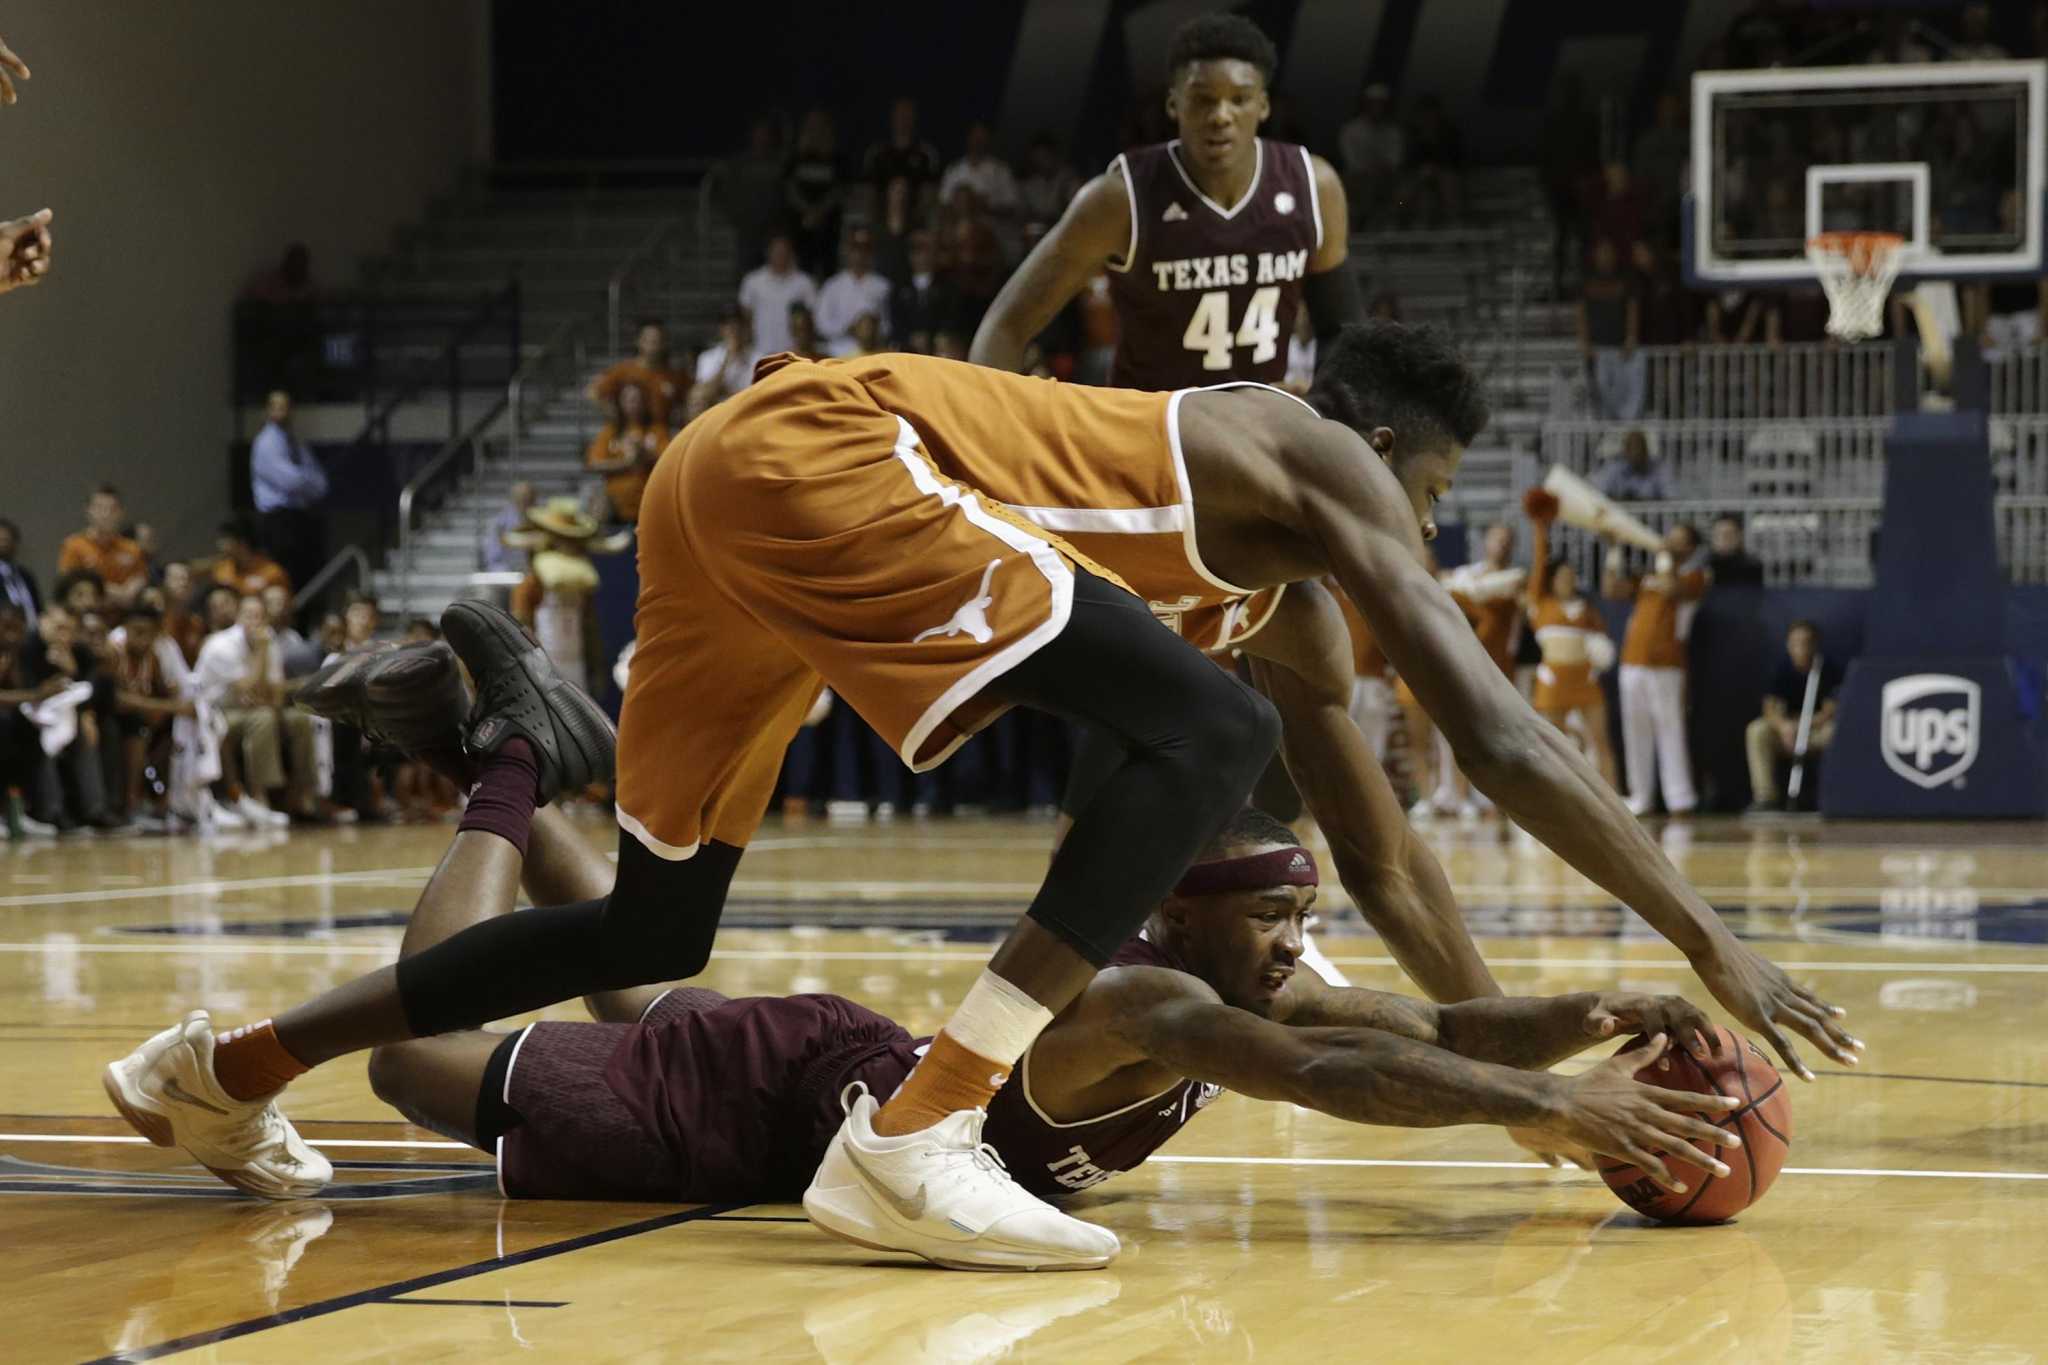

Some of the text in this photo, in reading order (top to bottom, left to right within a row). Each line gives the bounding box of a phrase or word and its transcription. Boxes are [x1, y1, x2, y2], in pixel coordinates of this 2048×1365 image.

[1152, 249, 1308, 291] TEXAS A&M
[1183, 286, 1281, 371] 44
[1889, 708, 1968, 770] ups
